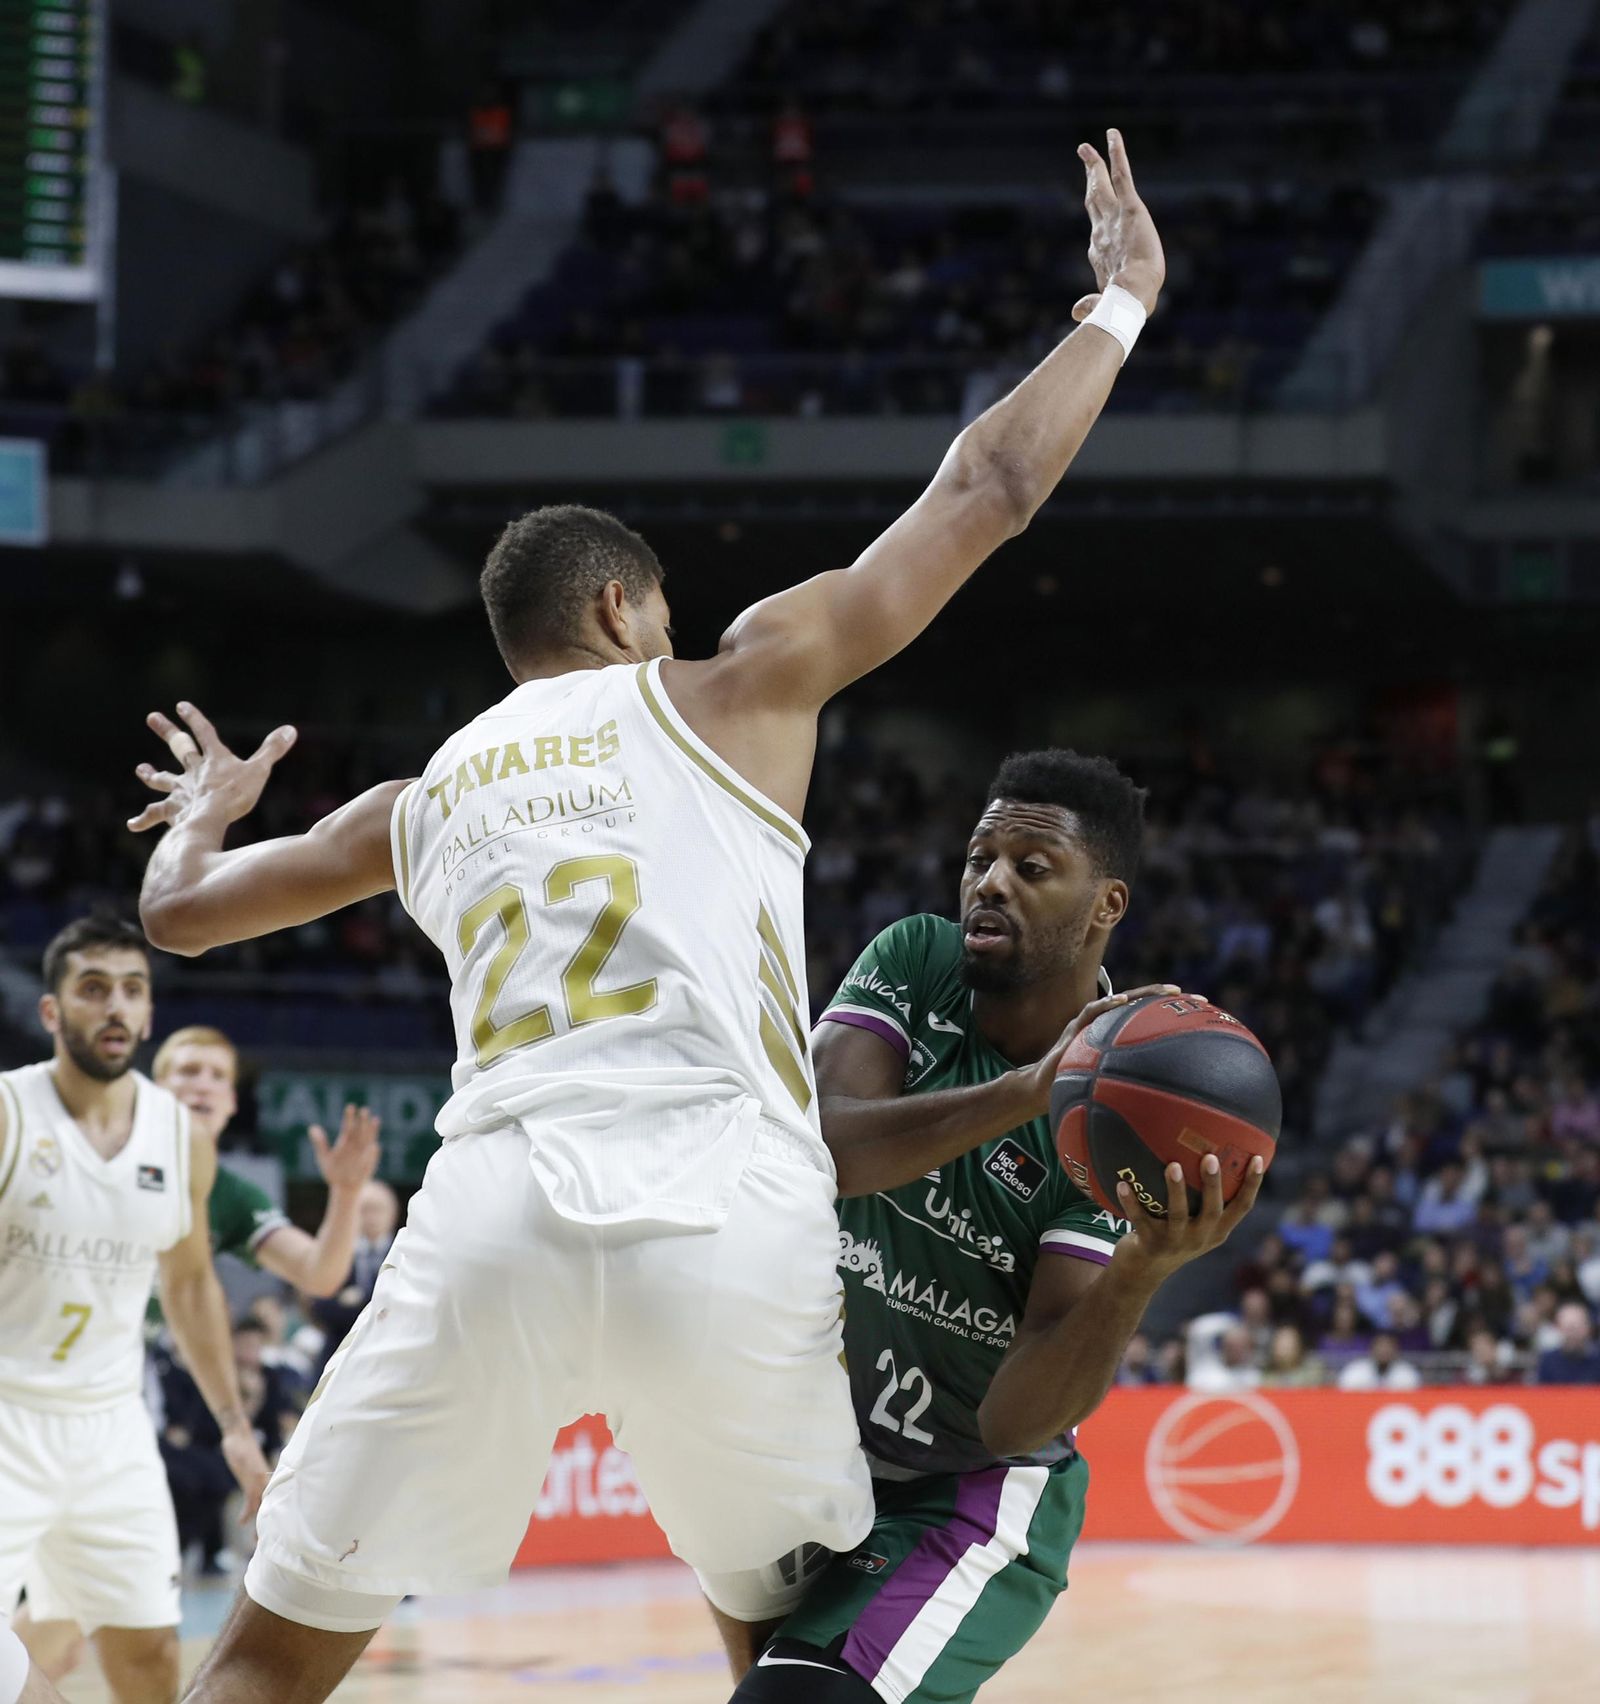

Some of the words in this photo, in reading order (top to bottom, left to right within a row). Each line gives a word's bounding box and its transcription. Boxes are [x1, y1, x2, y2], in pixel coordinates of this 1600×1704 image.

[427, 719, 620, 821] TAVARES
[442, 777, 633, 875] PALLADIUM
[445, 842, 512, 896] HOTEL
[537, 812, 636, 839] GROUP
[456, 853, 658, 1069] 22
[990, 1161, 1032, 1197] endesa
[997, 1151, 1019, 1172] liga
[925, 1187, 1015, 1272] Unicaja
[51, 1303, 93, 1361] 7
[886, 1297, 933, 1323] EUROPEAN
[934, 1318, 969, 1338] CAPITAL
[971, 1332, 986, 1342] OF
[888, 1270, 1016, 1338] MÁLAGA
[869, 1348, 934, 1446] 22
